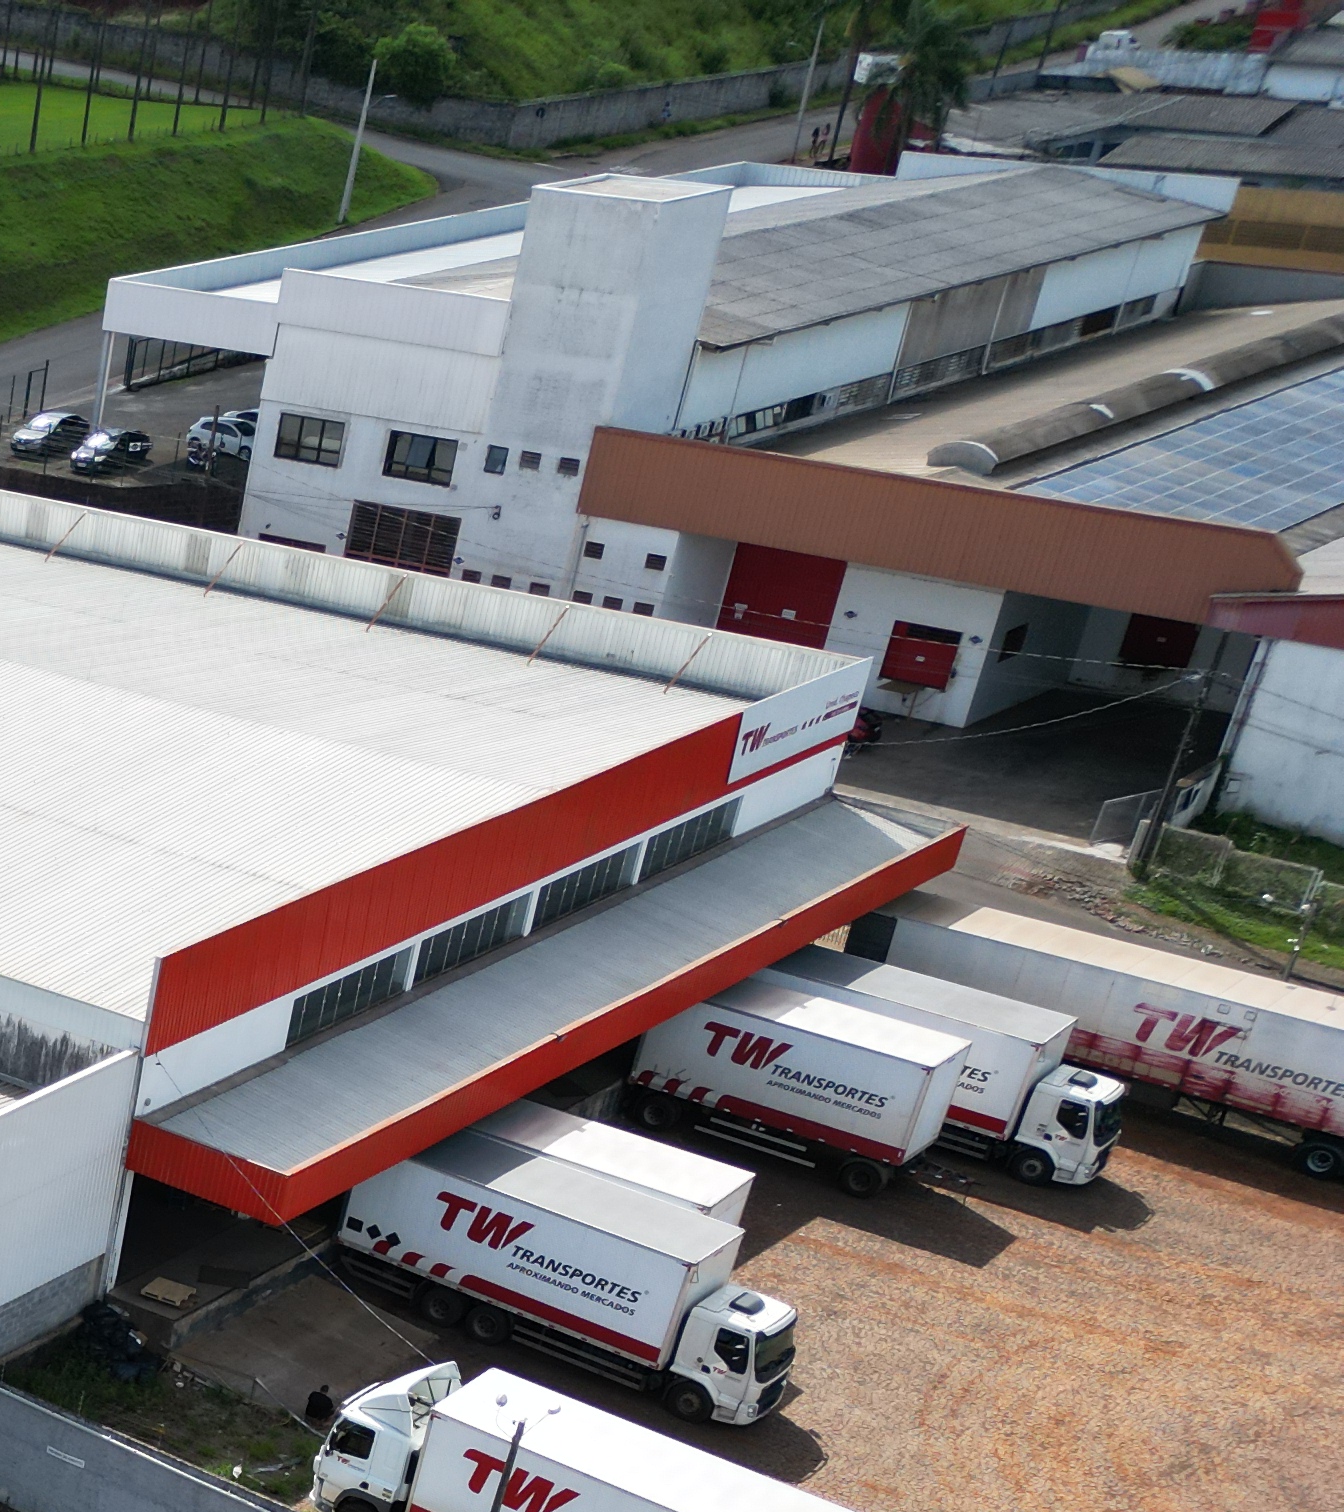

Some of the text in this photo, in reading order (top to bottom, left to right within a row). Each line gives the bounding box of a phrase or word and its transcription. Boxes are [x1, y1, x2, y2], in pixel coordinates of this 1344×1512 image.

[741, 722, 772, 756] TW
[703, 1021, 889, 1109] TW TRANSPORTES
[1133, 1002, 1243, 1058] TW
[1214, 1050, 1344, 1098] TRANSPORTE
[766, 1079, 883, 1120] APROXIMANDO MERCADOS
[436, 1190, 642, 1304] TW TRANSPORTES
[506, 1261, 637, 1317] APROXIMANDO MERCADOS
